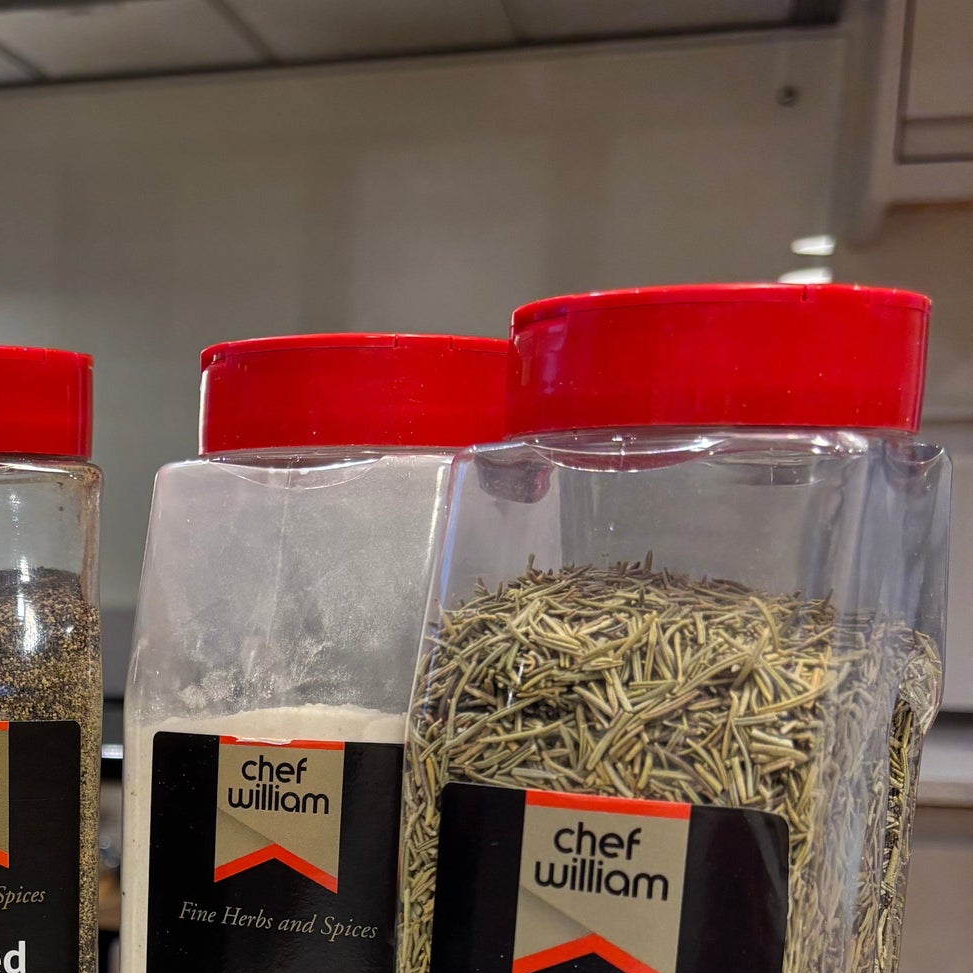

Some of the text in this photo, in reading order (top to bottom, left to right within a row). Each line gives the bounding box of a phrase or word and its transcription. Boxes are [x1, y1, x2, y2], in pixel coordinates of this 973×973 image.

[242, 755, 307, 784] chef
[228, 783, 330, 814] william
[553, 821, 641, 860] chef
[534, 858, 668, 900] william
[179, 901, 378, 942] Fine Herbs and Spices
